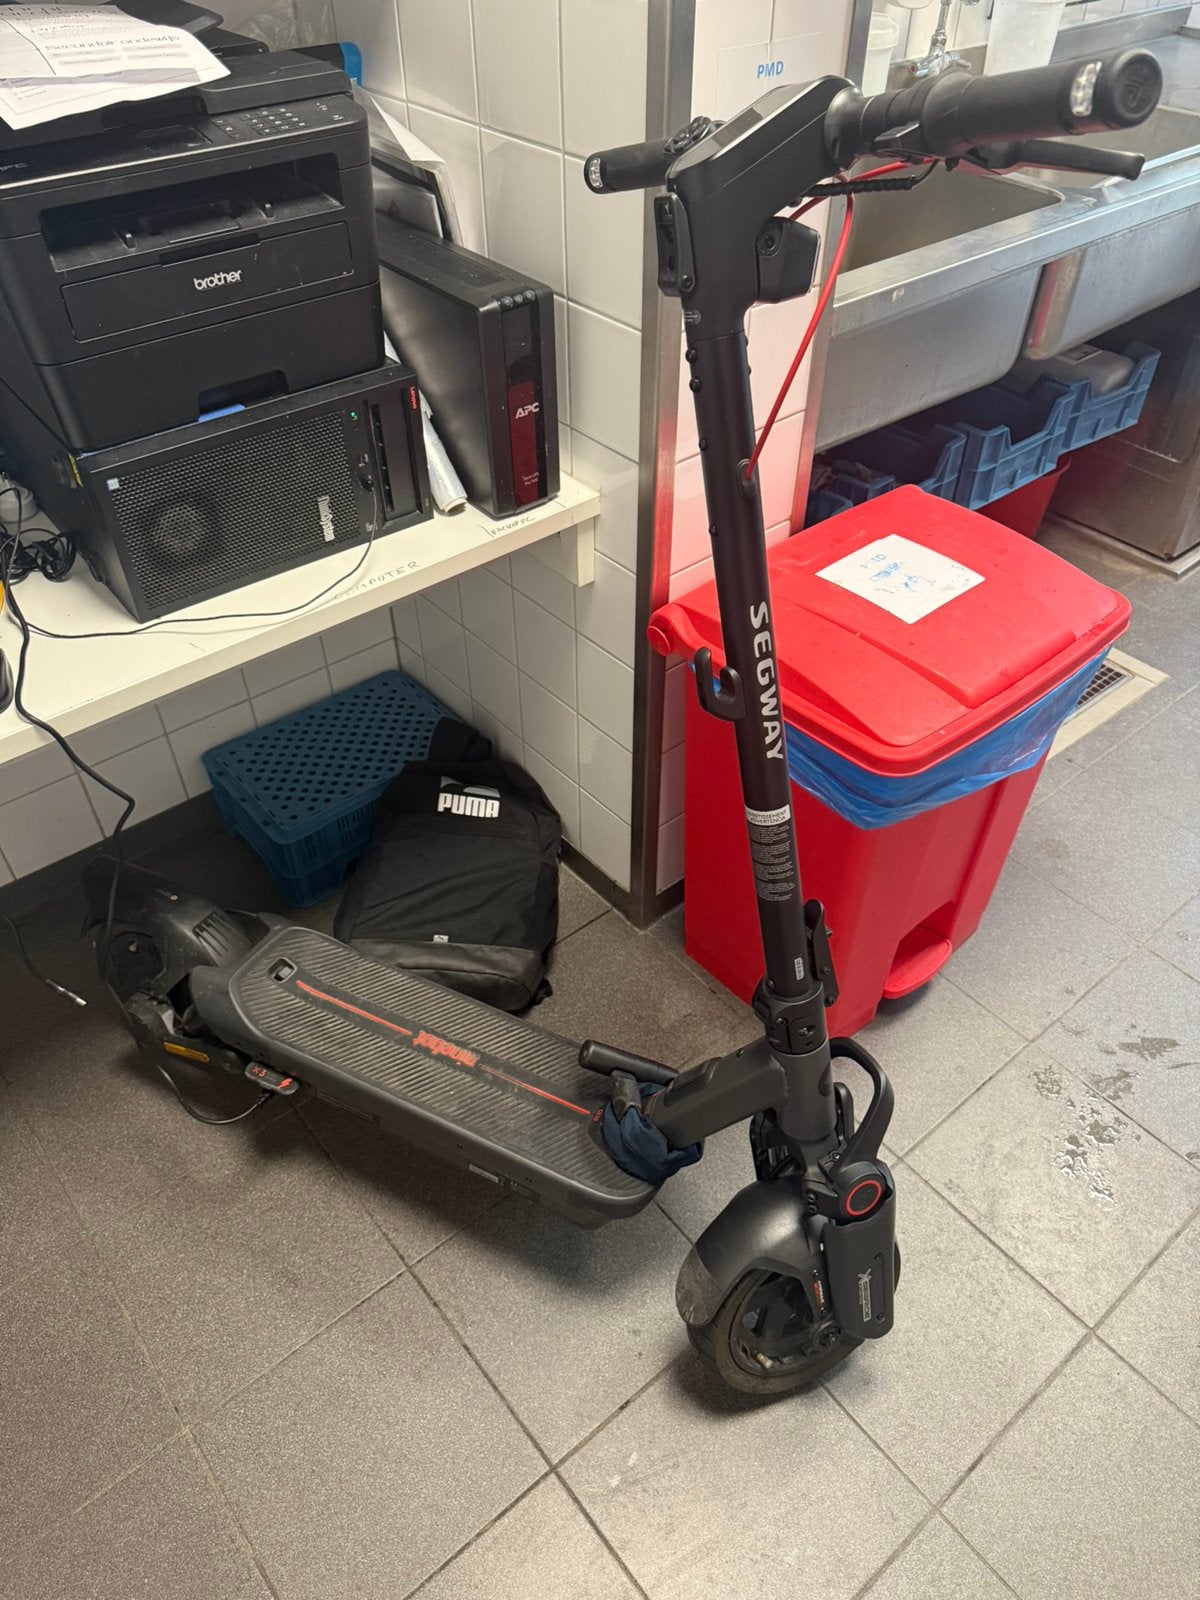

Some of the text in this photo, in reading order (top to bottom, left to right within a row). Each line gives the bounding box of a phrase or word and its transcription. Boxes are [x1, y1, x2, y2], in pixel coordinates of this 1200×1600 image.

[757, 61, 784, 79] PMD
[193, 269, 242, 290] brother
[515, 402, 540, 419] APC
[317, 495, 335, 541] ThinkSystem
[750, 601, 784, 760] SEGWAY
[437, 792, 500, 818] PUMA
[412, 1030, 480, 1068] ninebot
